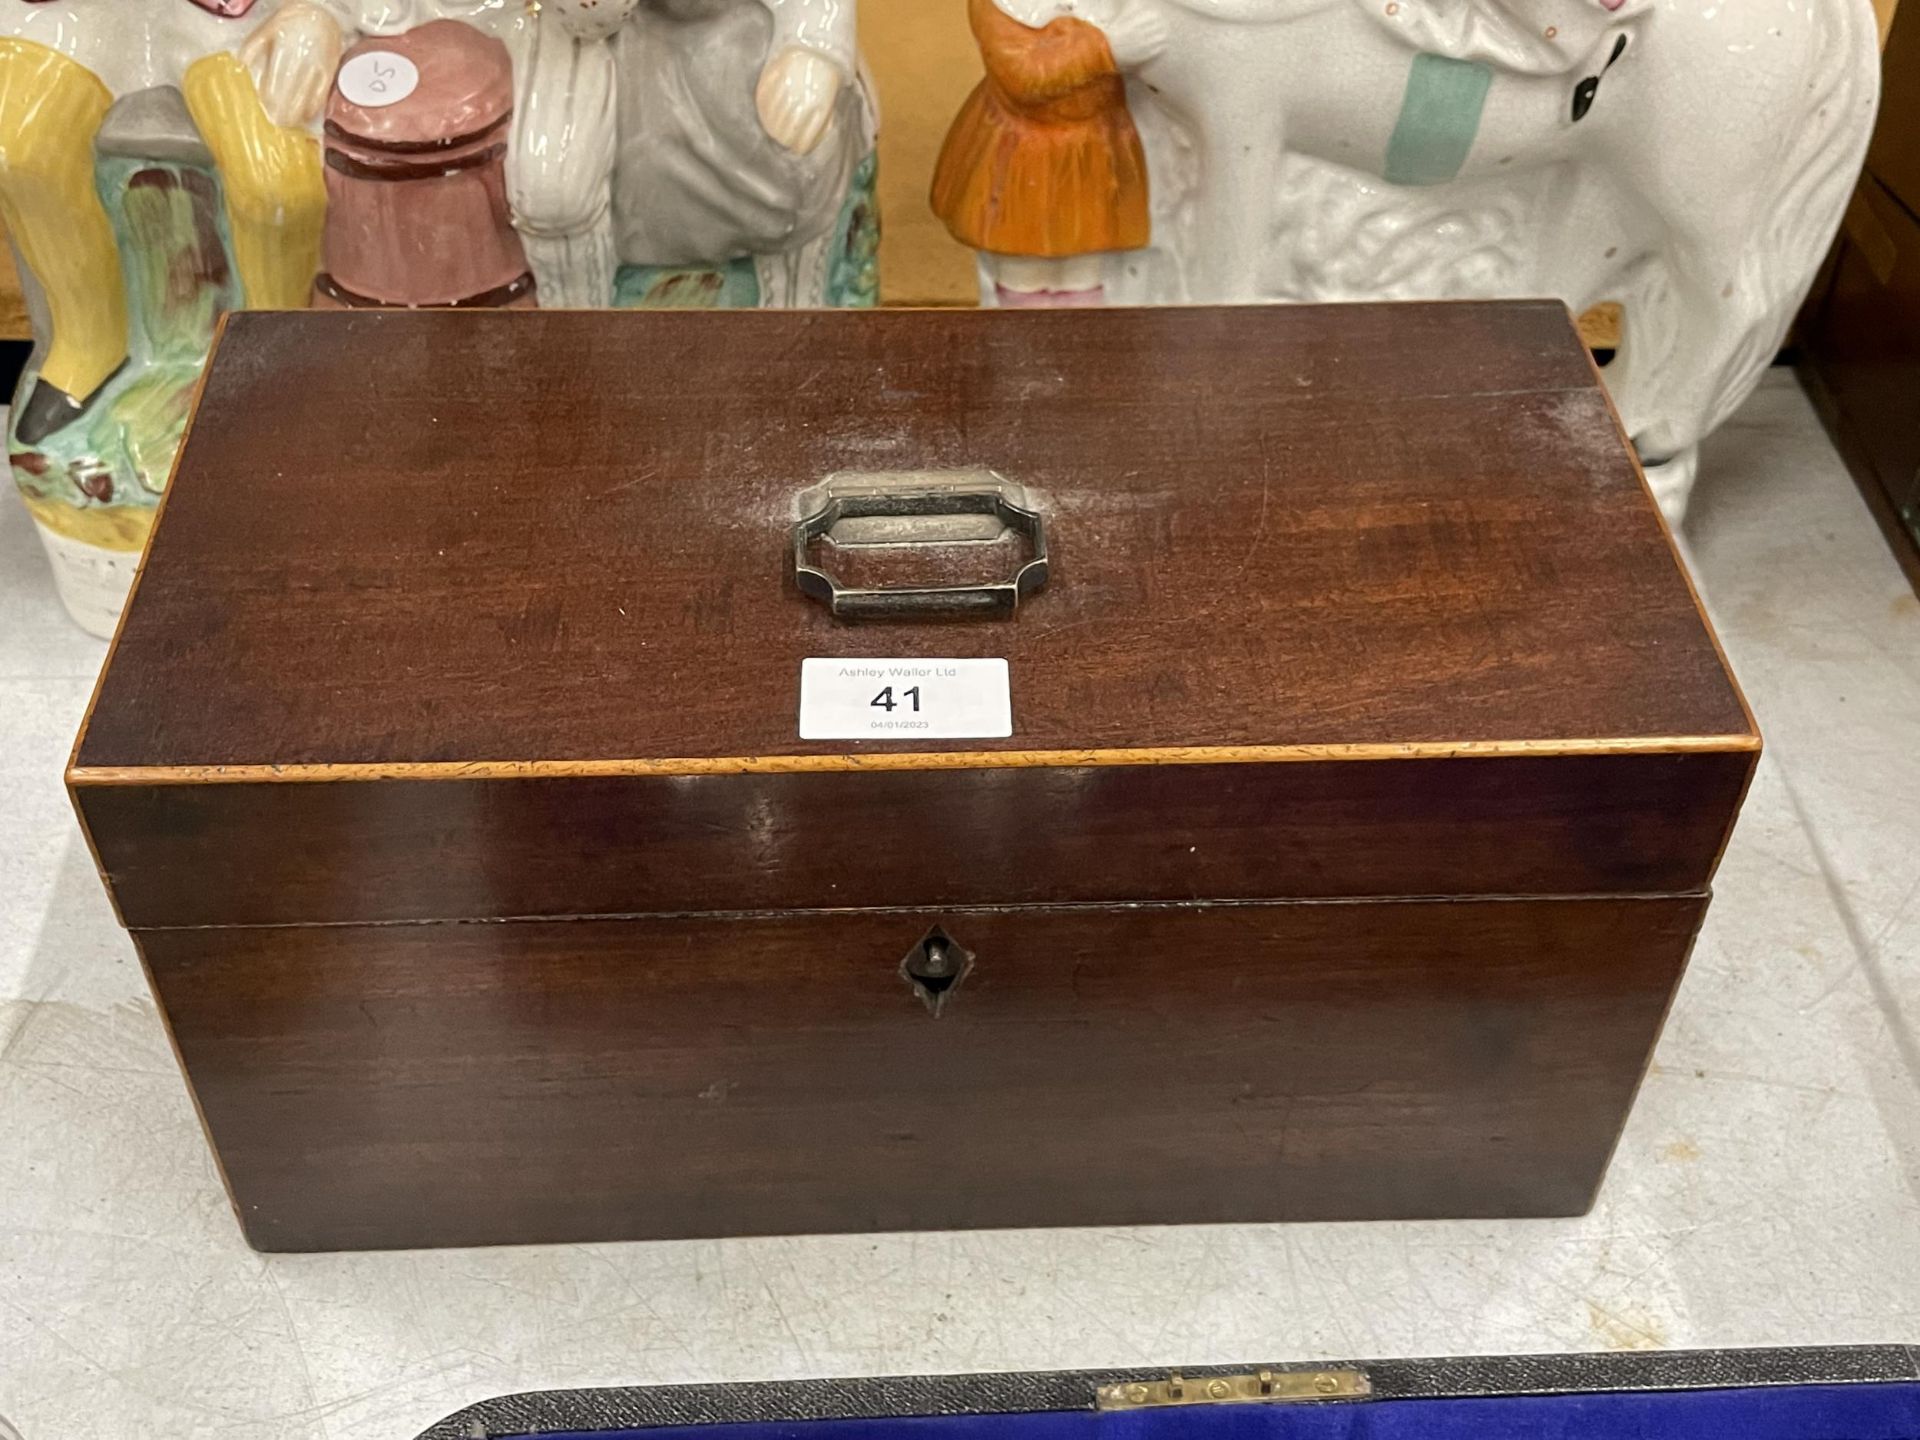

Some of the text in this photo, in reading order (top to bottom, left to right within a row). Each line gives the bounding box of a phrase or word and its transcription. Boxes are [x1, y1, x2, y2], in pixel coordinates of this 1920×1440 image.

[838, 667, 885, 679] Ashley
[935, 667, 957, 678] Ltd
[870, 686, 920, 712] 41
[870, 721, 929, 729] 04/01/2023
